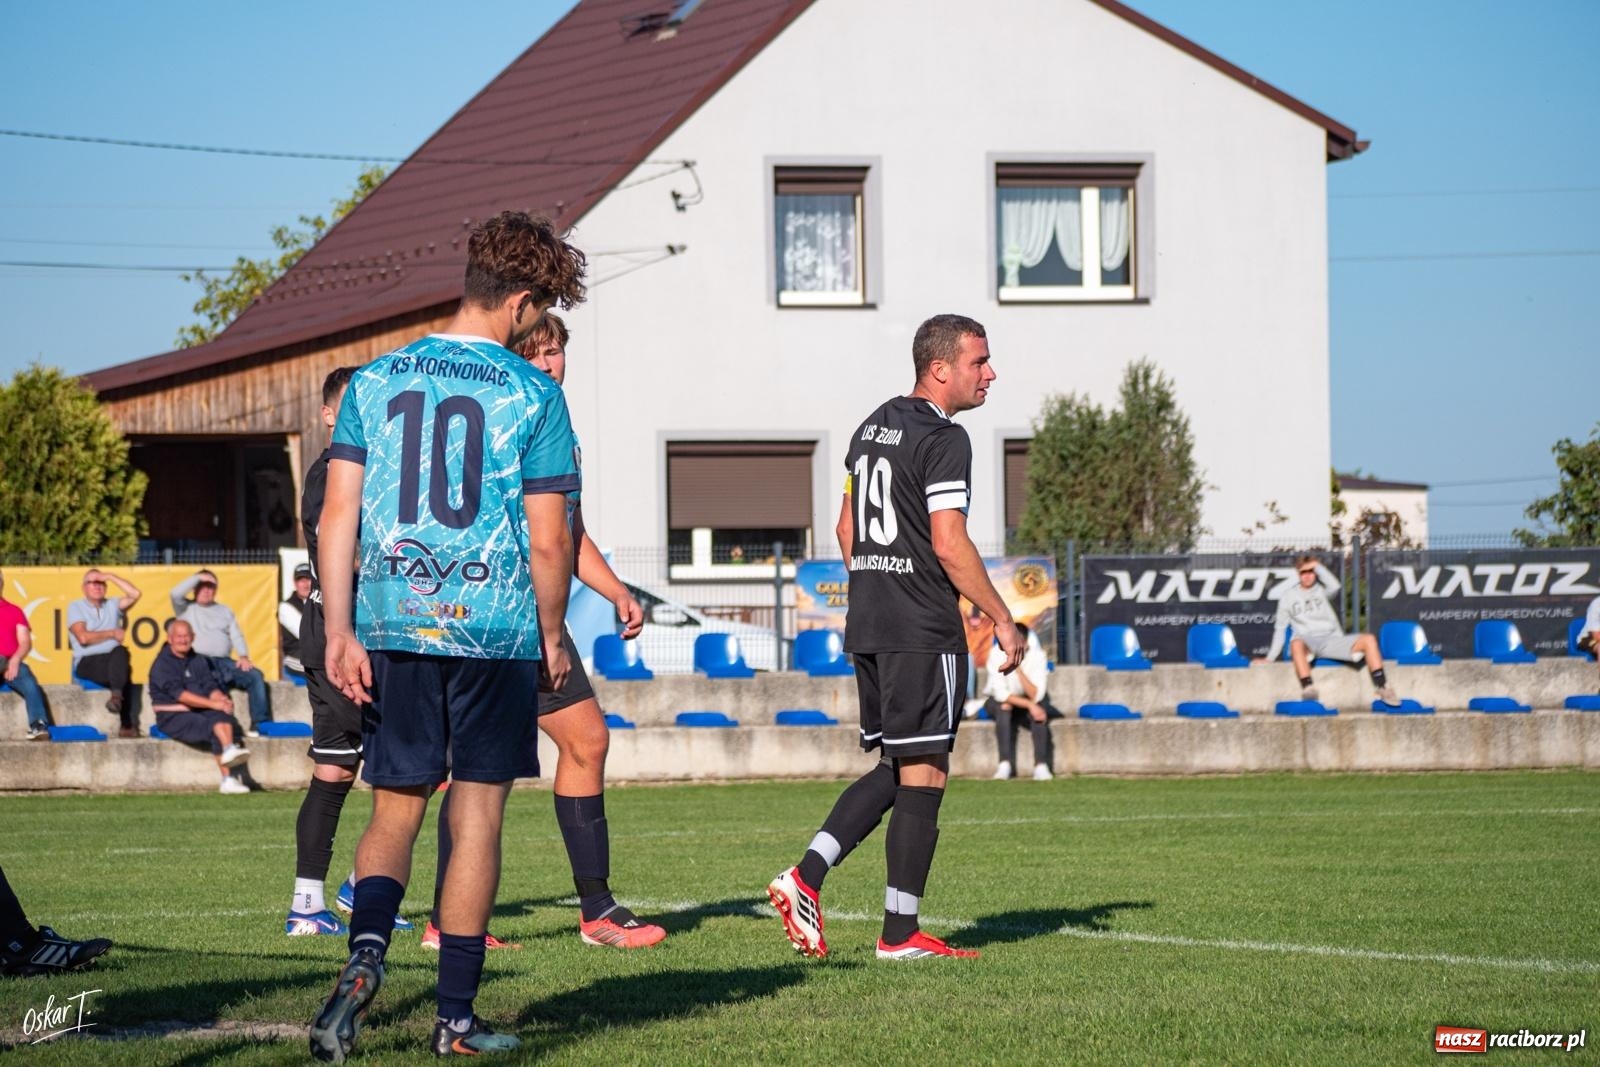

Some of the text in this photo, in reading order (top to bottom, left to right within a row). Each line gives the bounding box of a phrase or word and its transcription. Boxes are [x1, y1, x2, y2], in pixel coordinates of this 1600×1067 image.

[389, 356, 509, 387] KS KORNOWAC
[386, 390, 486, 530] 10
[854, 454, 898, 546] 19
[382, 555, 490, 582] TAVO
[1381, 561, 1600, 600] MATOZ
[1134, 614, 1197, 626] KAMPERY
[1419, 607, 1574, 621] KAMPERY EKSPEDYCYJNE
